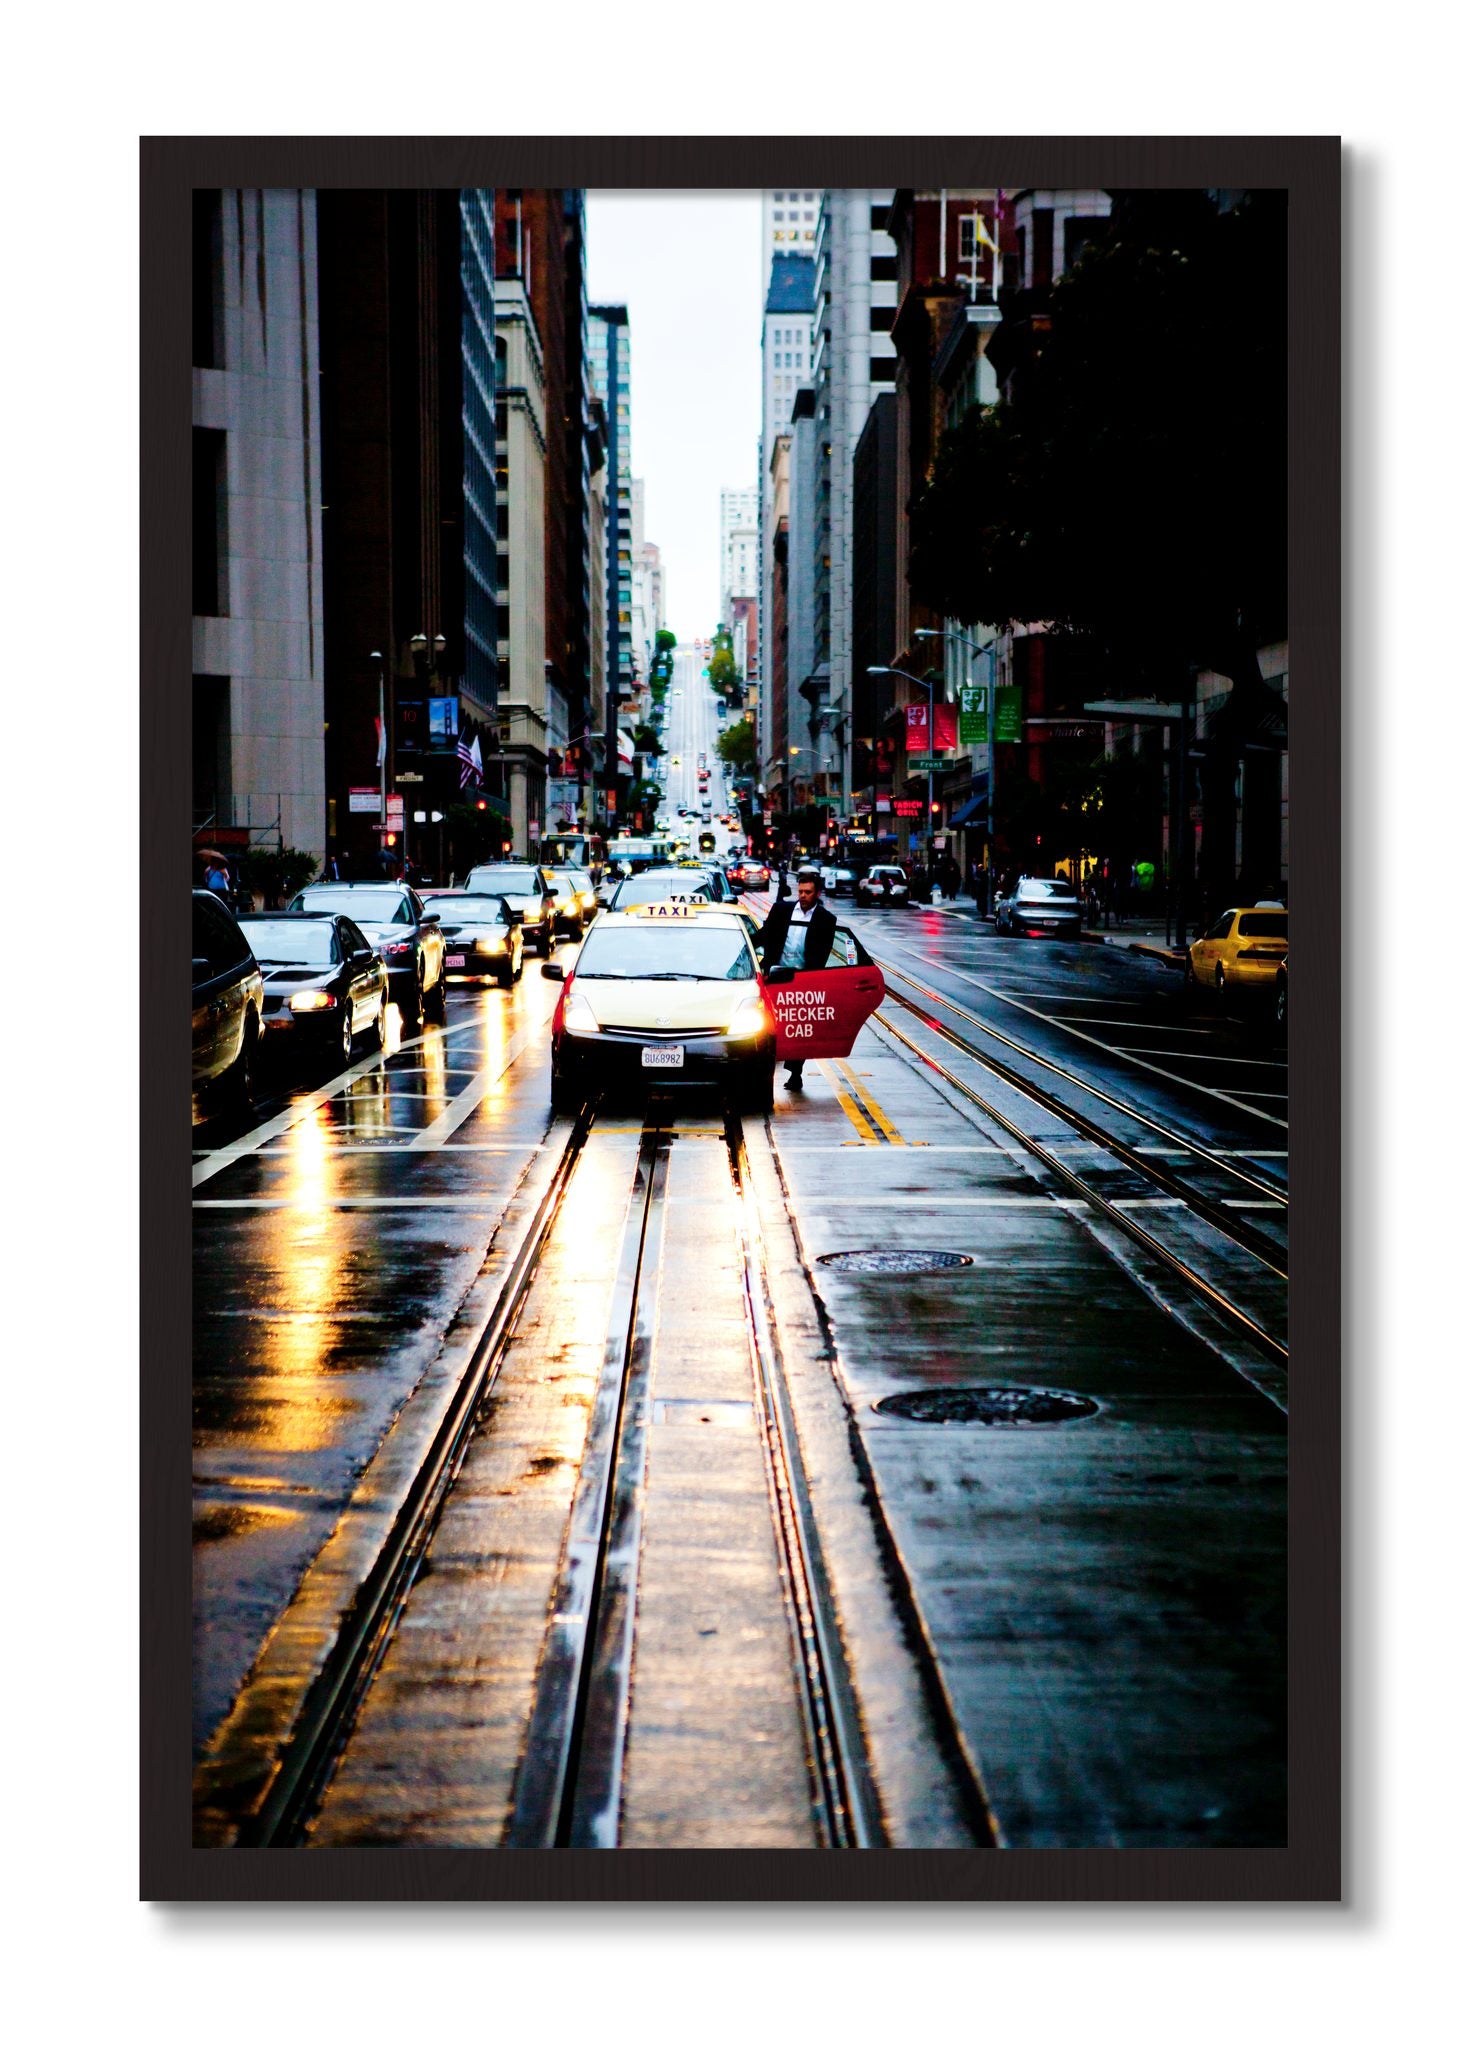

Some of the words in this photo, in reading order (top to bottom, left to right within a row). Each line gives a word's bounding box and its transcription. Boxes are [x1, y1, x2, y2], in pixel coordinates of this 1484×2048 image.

[897, 809, 919, 817] GRILL
[670, 895, 703, 903] TAXI
[648, 906, 687, 916] TAXI
[776, 991, 826, 1006] ARROW
[785, 1023, 813, 1038] CAB
[645, 1053, 681, 1064] 8U68982
